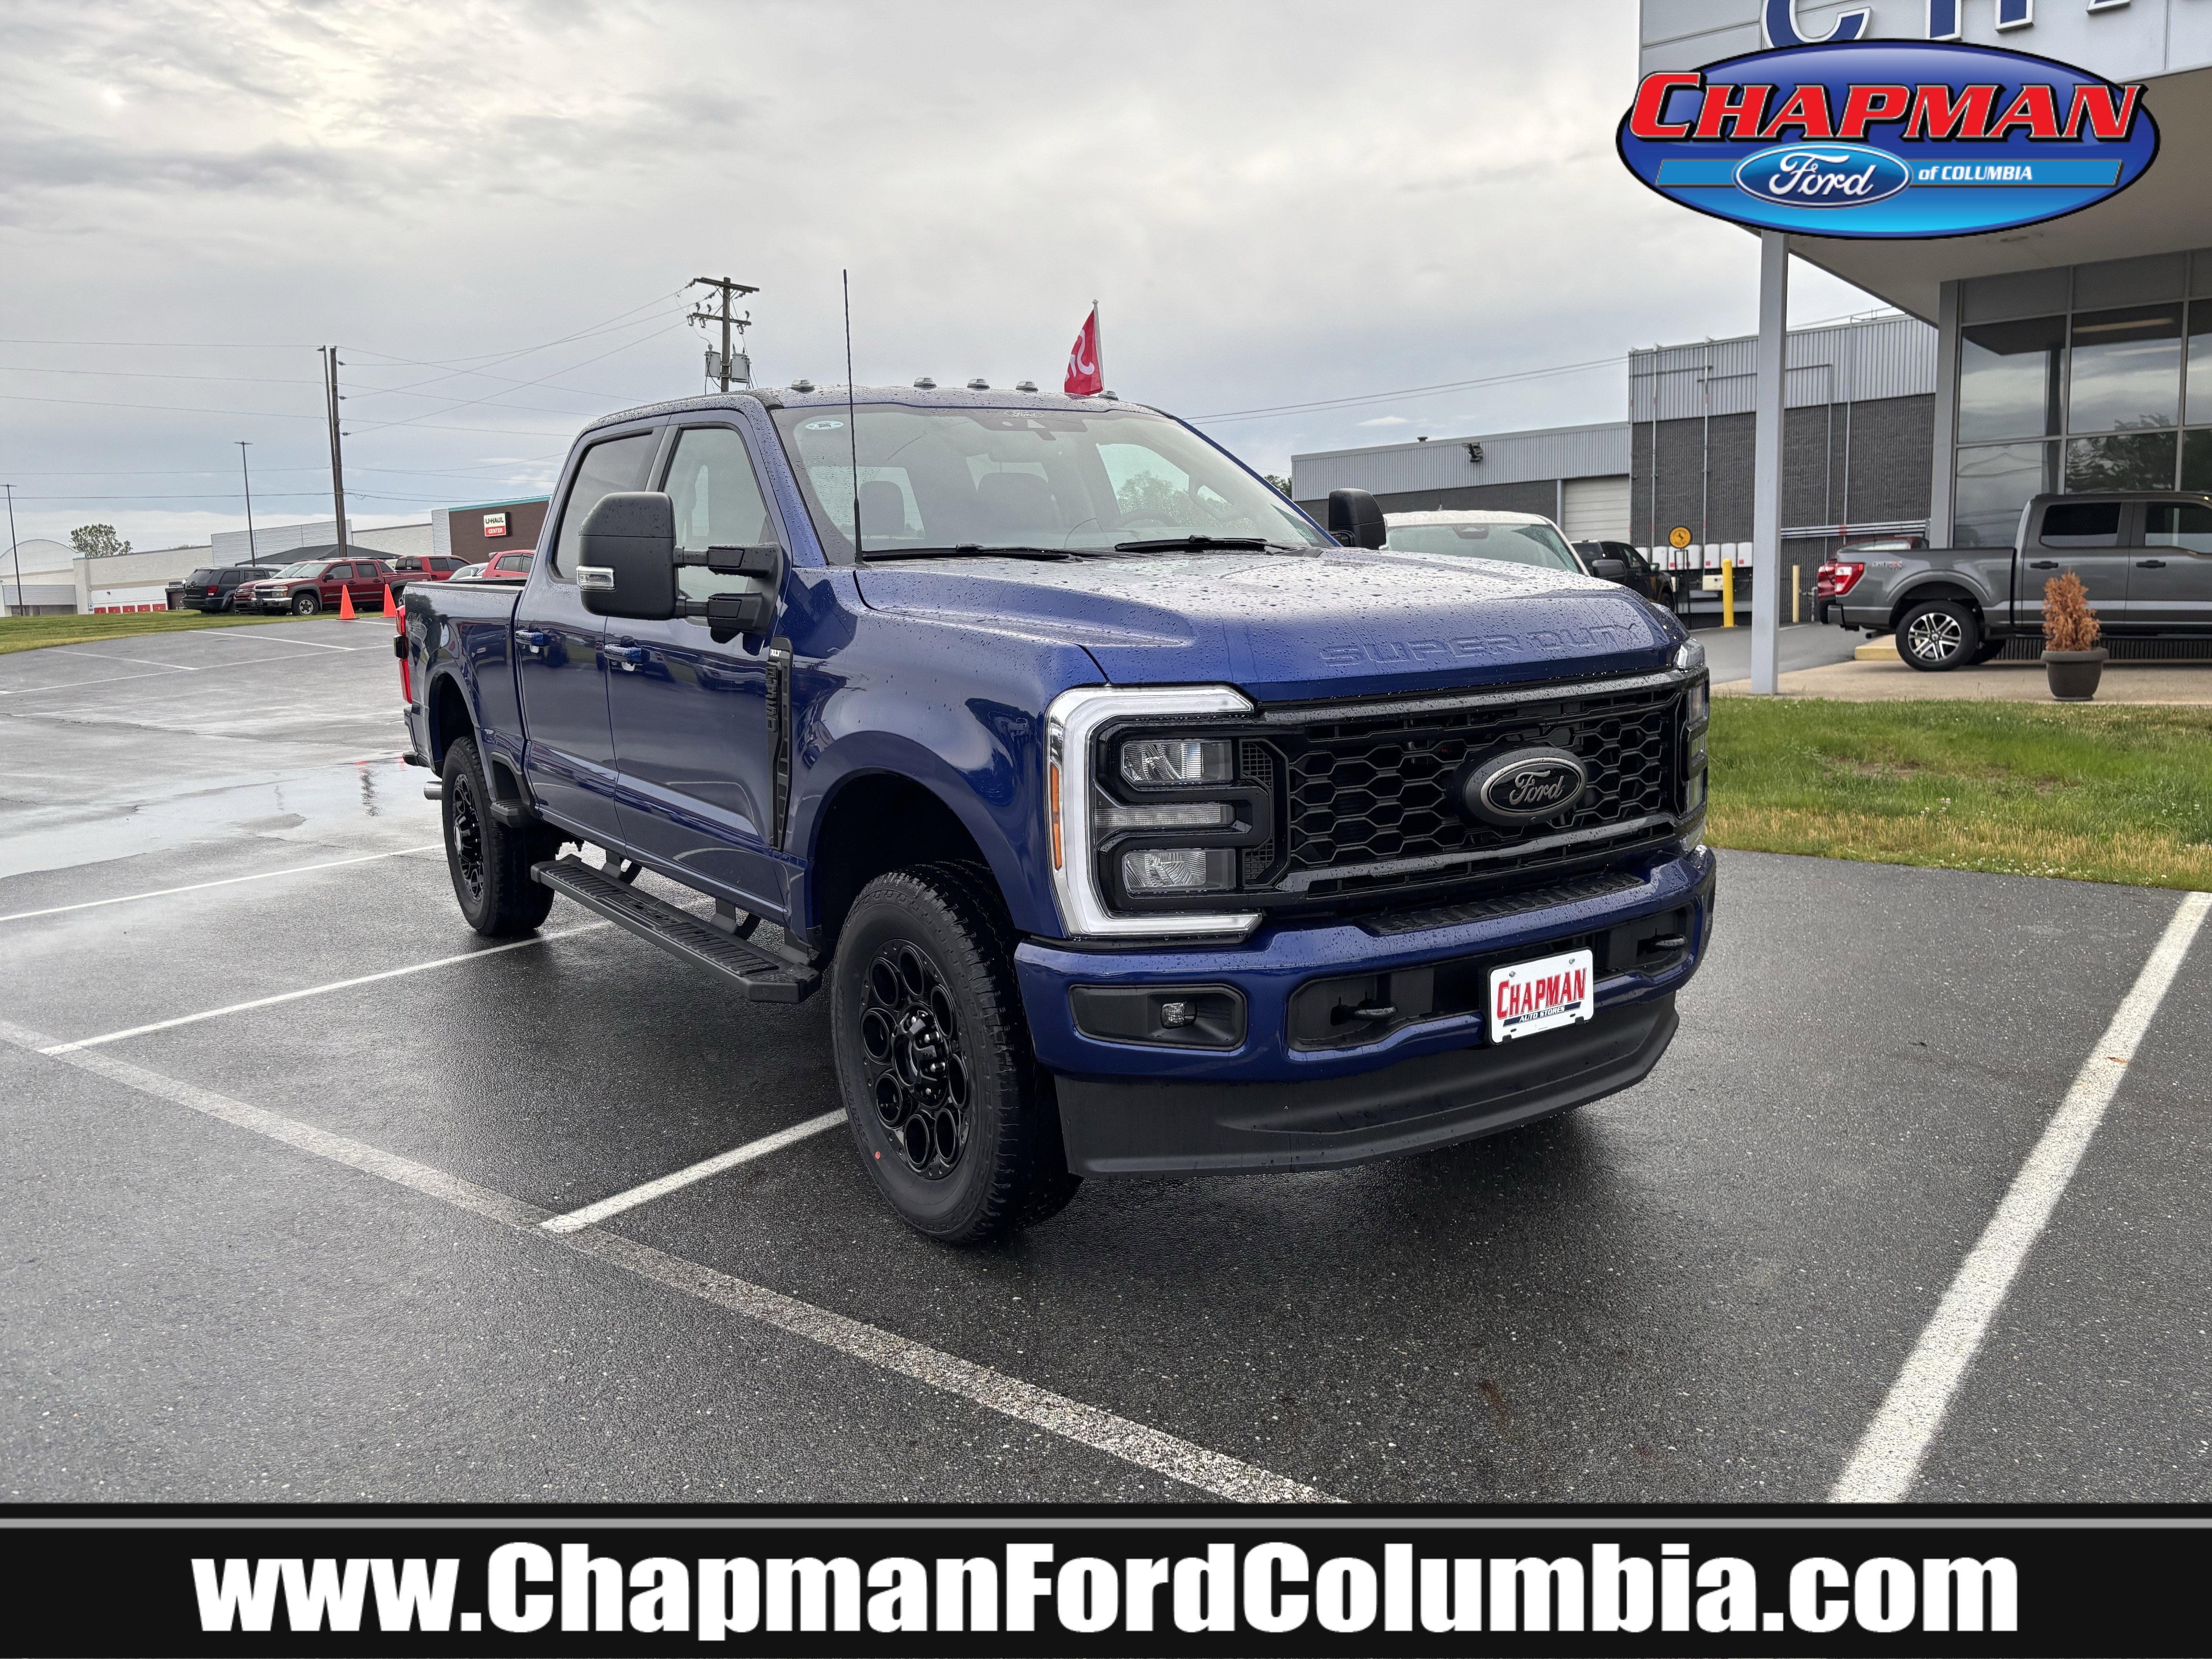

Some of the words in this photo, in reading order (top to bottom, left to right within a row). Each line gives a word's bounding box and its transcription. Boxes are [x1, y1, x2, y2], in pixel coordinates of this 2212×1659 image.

[771, 649, 782, 657] XLT
[1319, 634, 1524, 667] SUPER
[1527, 622, 1640, 651] DUTY
[1509, 770, 1565, 805] Ford
[1497, 967, 1587, 1020] CHAPMAN
[1519, 1012, 1538, 1023] AUTO
[1539, 1005, 1565, 1018] STORES
